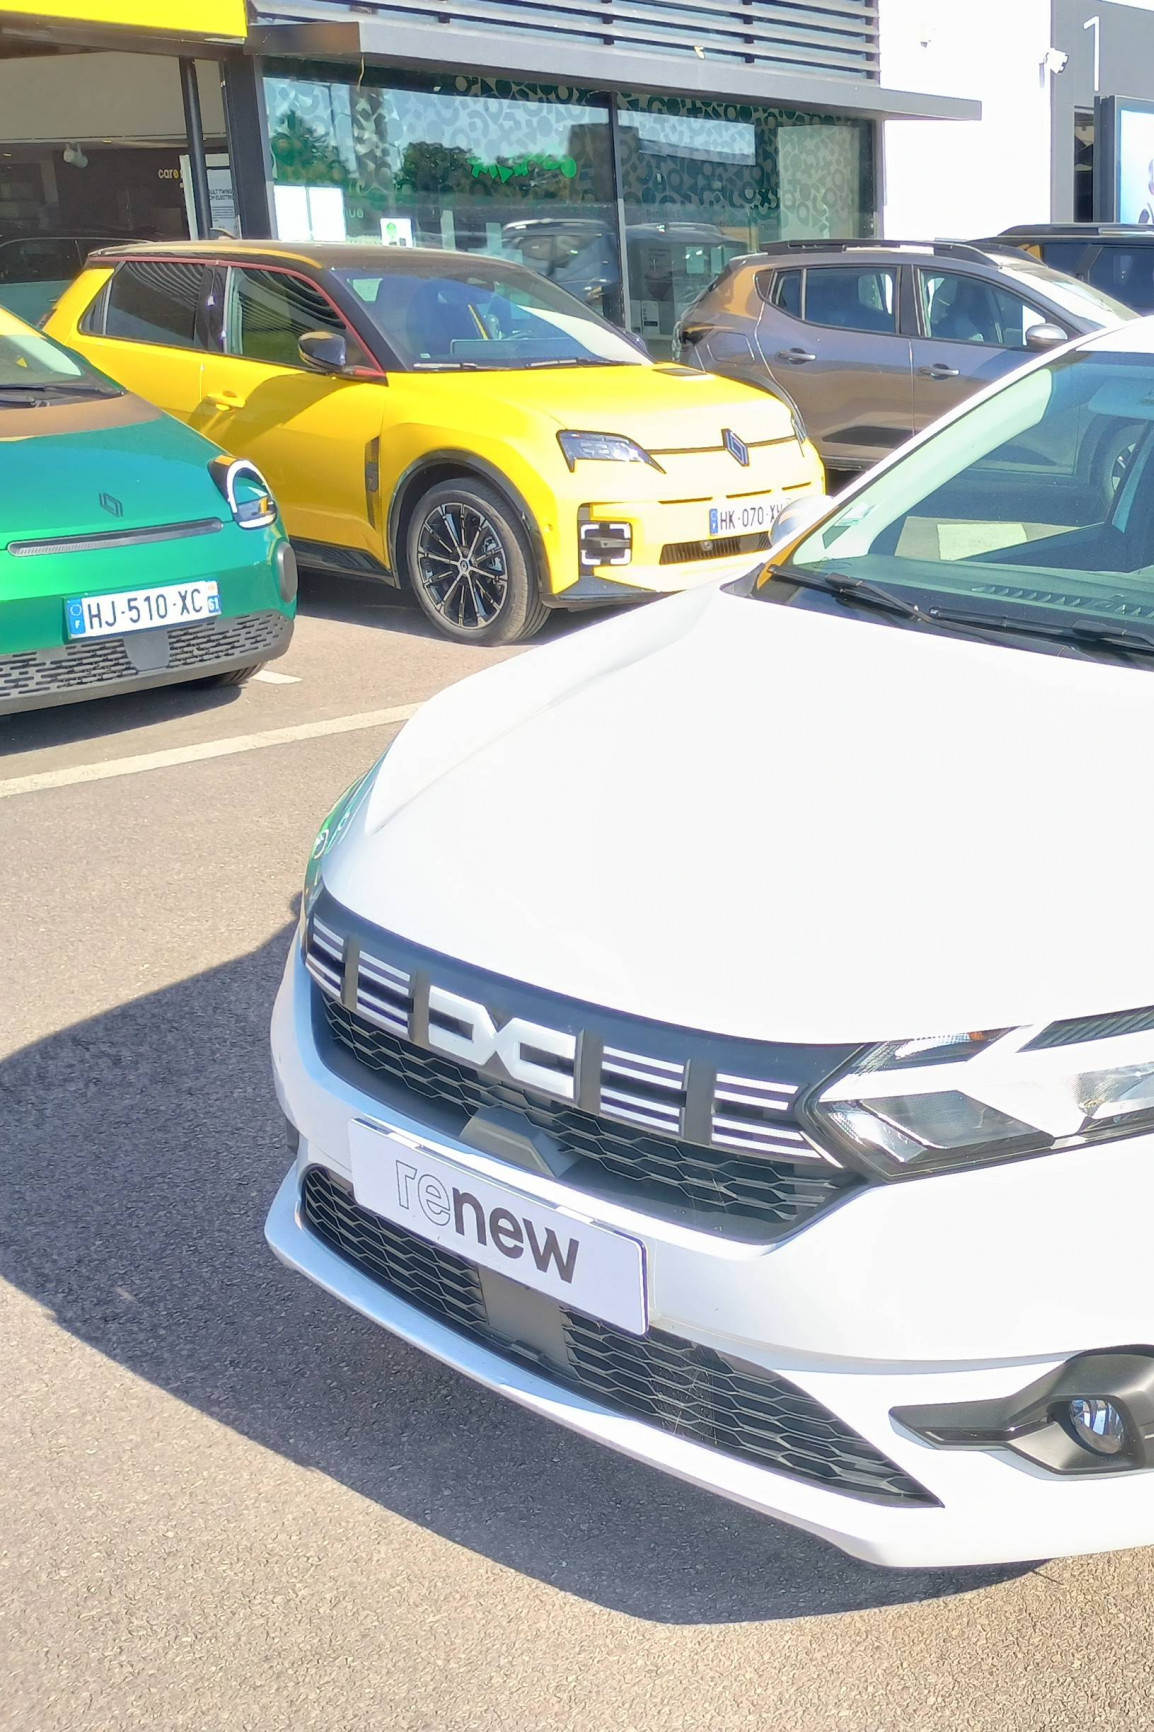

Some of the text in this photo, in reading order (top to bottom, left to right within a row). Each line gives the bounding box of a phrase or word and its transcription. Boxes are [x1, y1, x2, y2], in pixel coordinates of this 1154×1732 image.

[1083, 15, 1100, 92] 1
[157, 168, 180, 179] care
[87, 588, 203, 629] HJ-510-XC
[395, 1159, 580, 1285] renew
